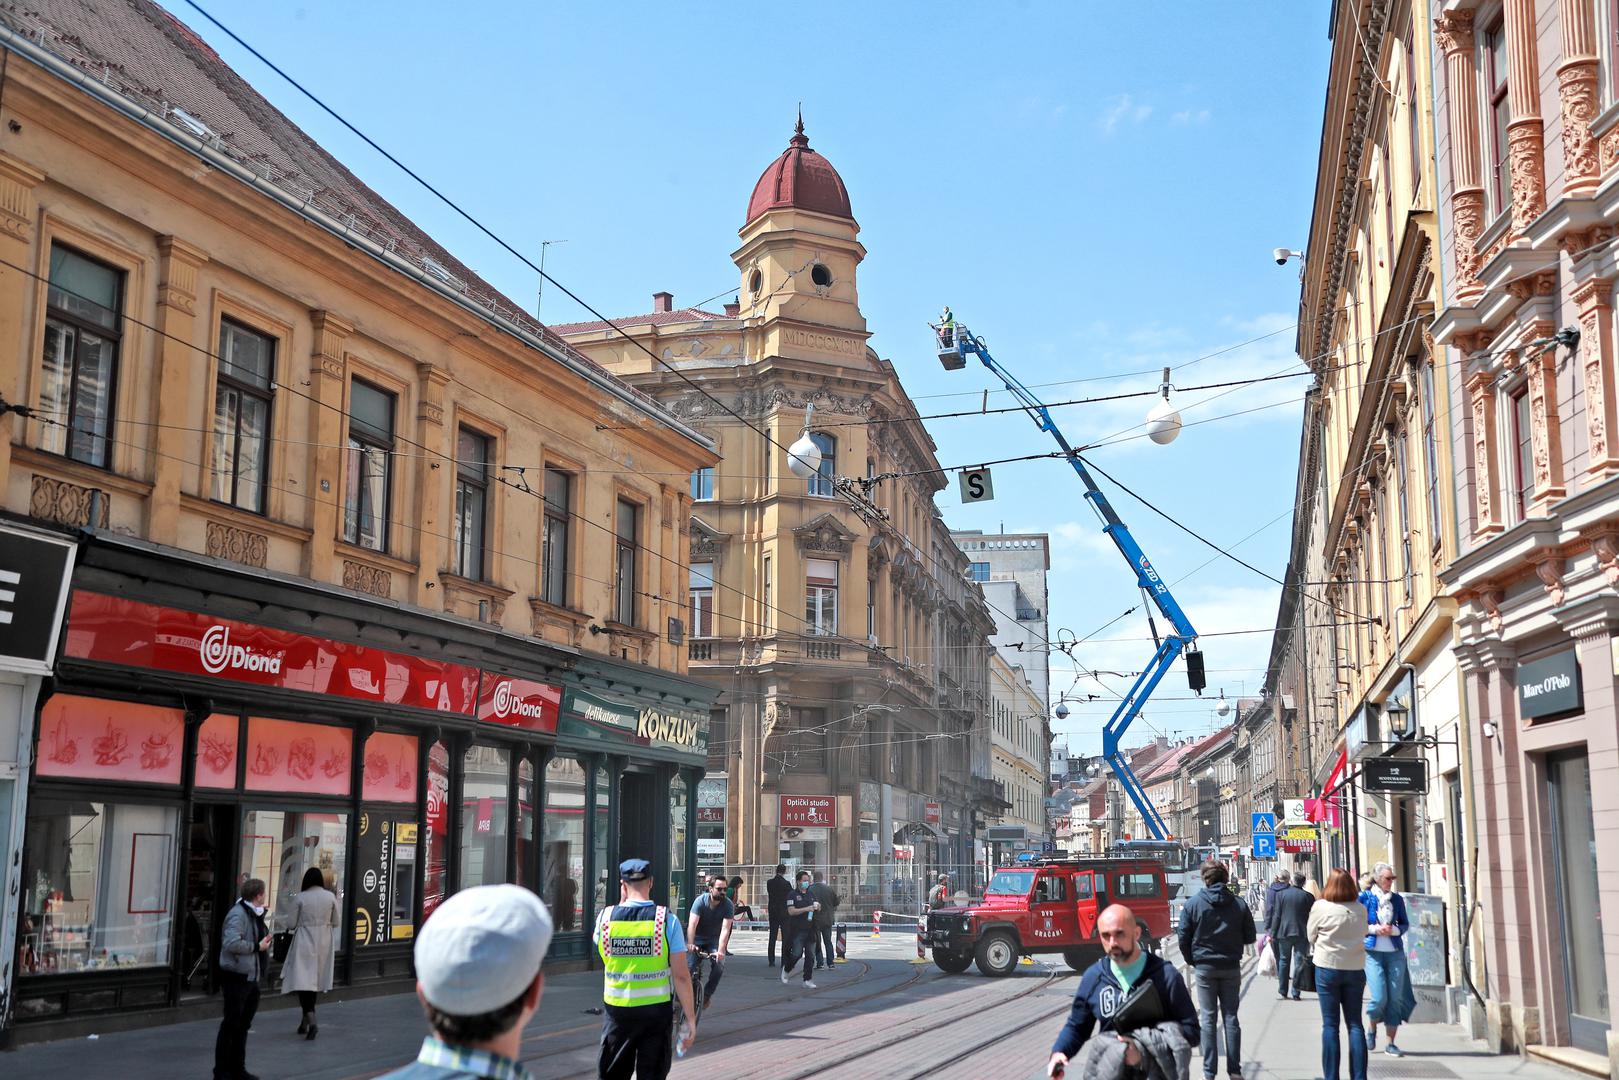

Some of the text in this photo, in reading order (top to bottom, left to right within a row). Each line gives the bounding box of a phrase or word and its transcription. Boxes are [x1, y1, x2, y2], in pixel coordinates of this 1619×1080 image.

[968, 473, 985, 499] S
[231, 645, 281, 674] Diona
[1523, 673, 1571, 698] Marc O'Polo
[511, 696, 543, 718] Diona
[637, 707, 699, 747] KONZUM
[786, 798, 830, 807] Optički studio
[1259, 838, 1270, 853] P
[1285, 839, 1315, 847] TOBACCO
[611, 946, 652, 955] REDARSTVO
[612, 938, 651, 948] PROMETNO
